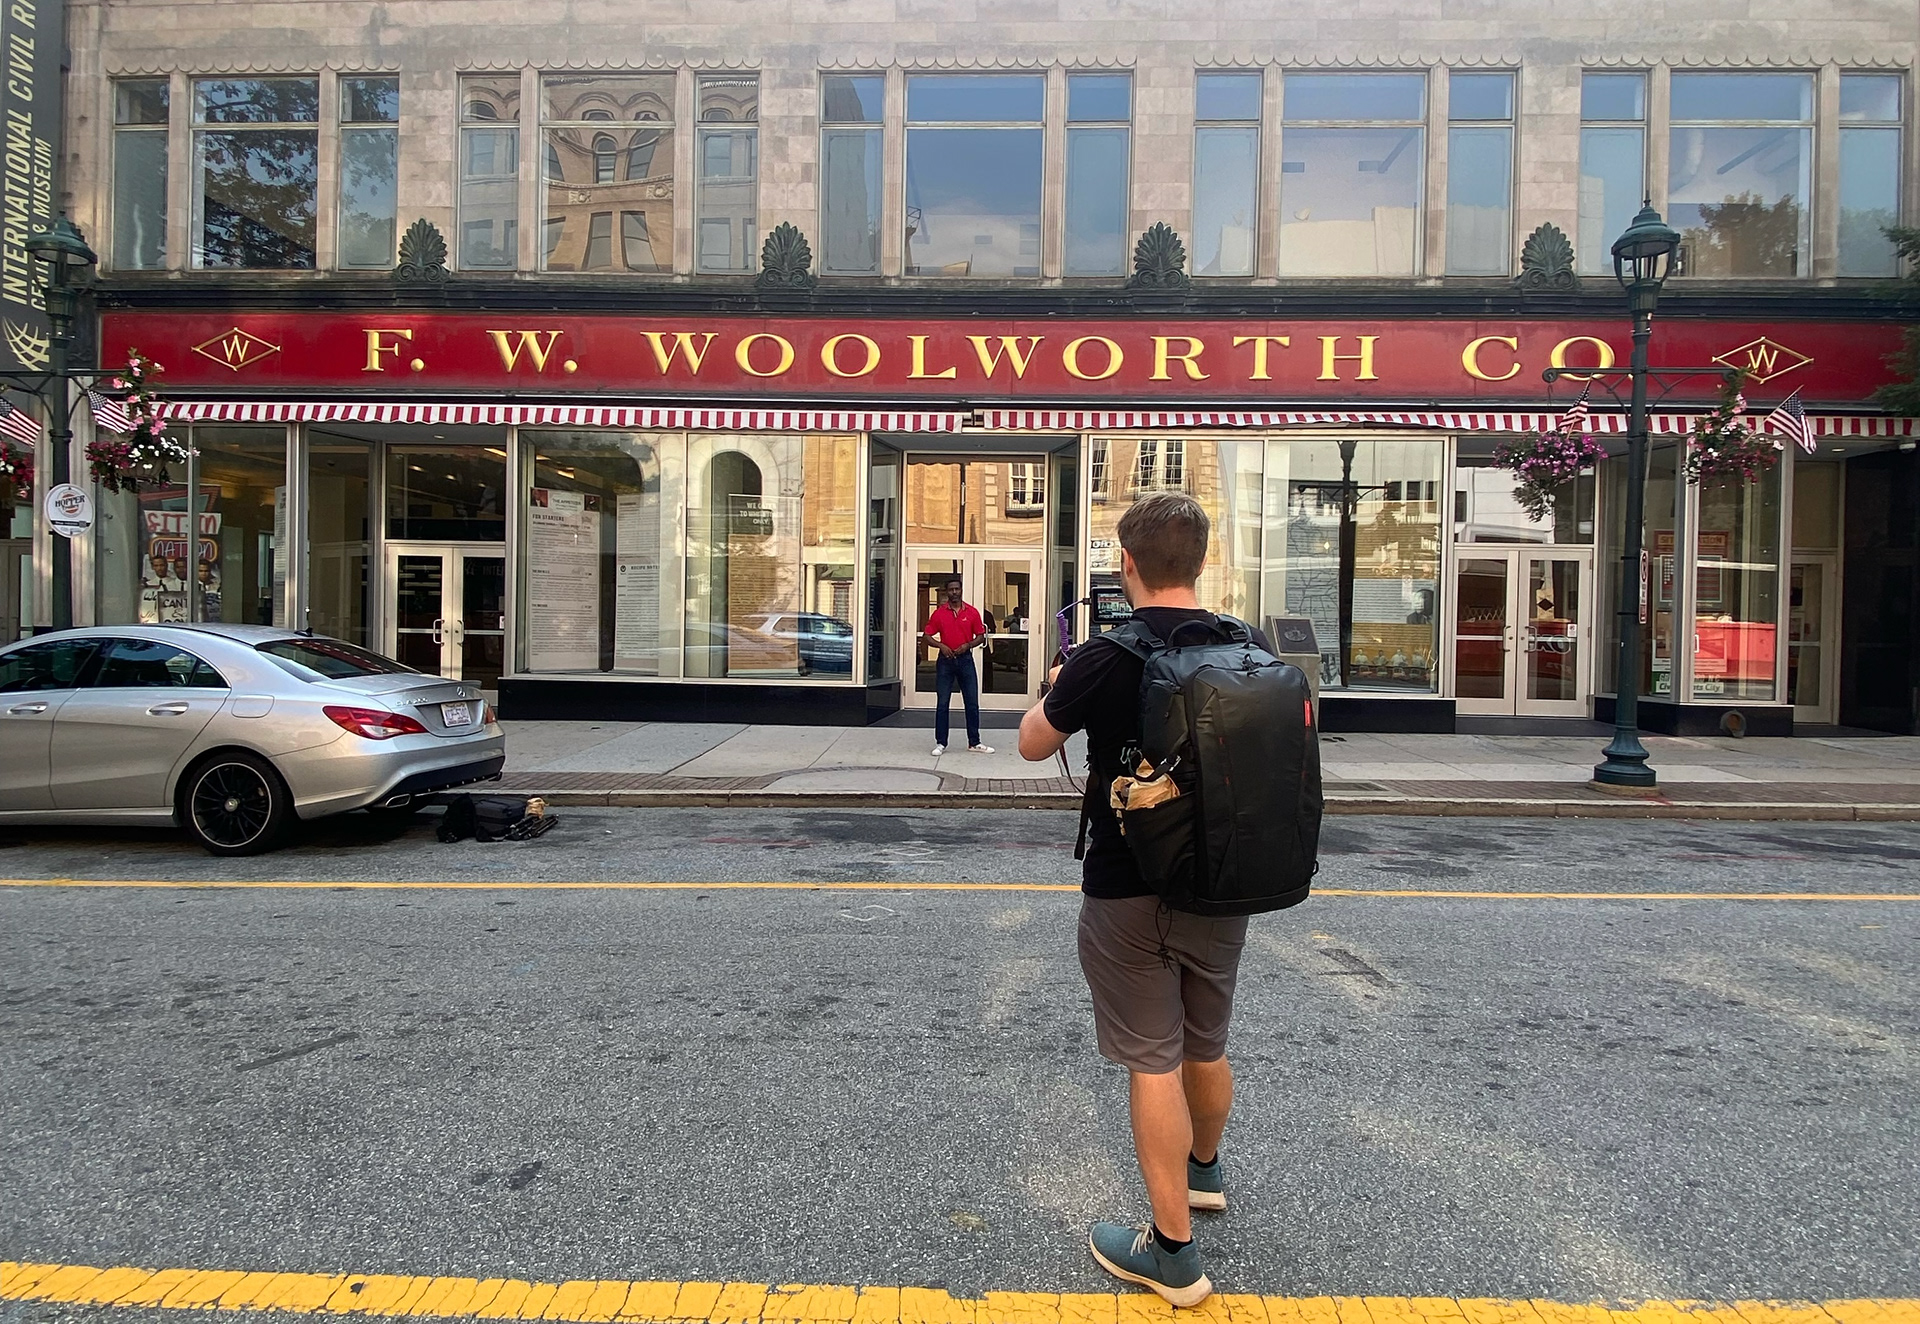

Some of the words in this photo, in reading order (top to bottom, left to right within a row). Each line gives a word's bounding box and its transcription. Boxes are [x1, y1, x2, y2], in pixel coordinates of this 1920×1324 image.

[8, 33, 35, 101] CIVIL
[32, 137, 52, 219] MUSEUM
[2, 108, 32, 305] INTERNATIONAL
[221, 334, 250, 363] W
[361, 328, 425, 373] F.
[486, 329, 578, 374] W.
[640, 331, 1380, 381] WOOLWORTH
[1747, 344, 1779, 374] W
[55, 495, 85, 507] HOPPER
[1705, 682, 1720, 693] City
